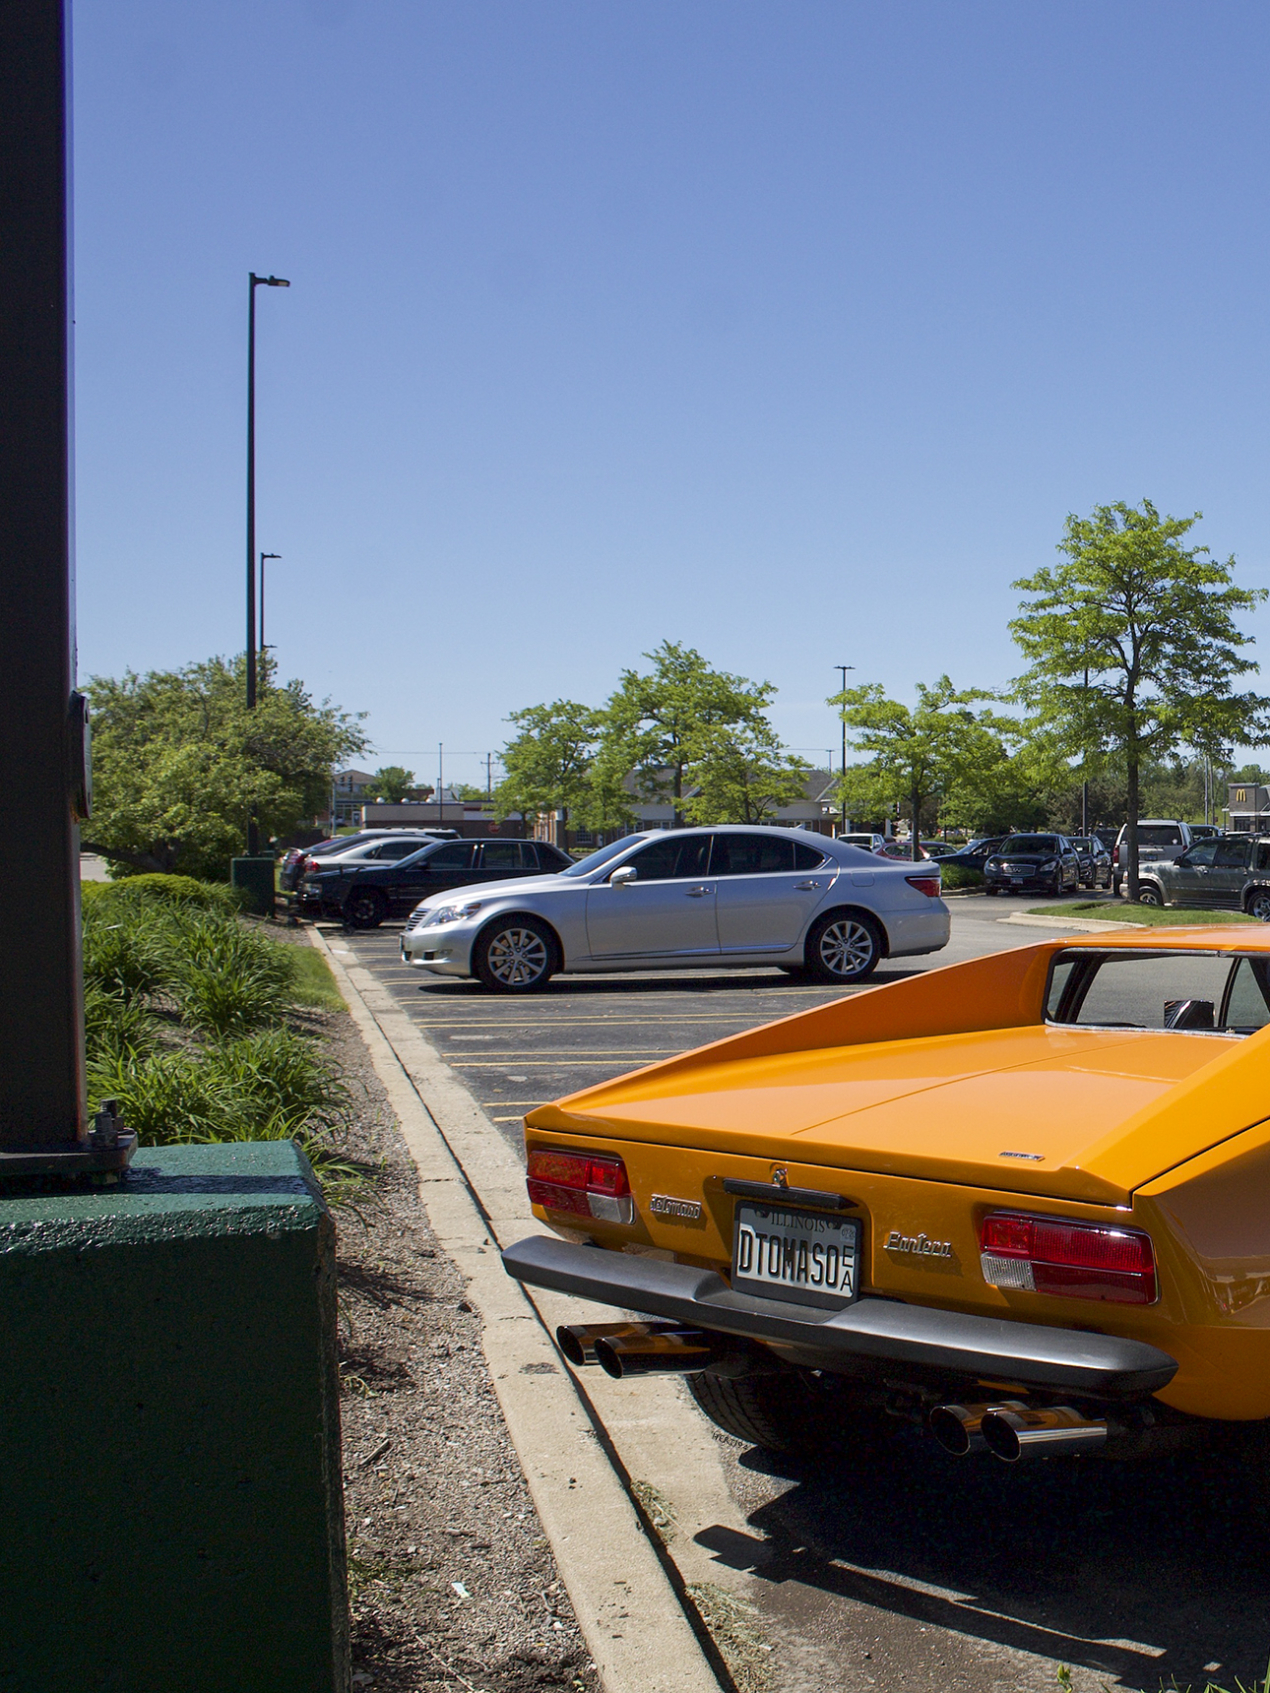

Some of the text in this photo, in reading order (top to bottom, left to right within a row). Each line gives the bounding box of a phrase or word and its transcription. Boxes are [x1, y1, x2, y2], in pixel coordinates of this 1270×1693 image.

[771, 1212, 825, 1233] ILLINOIS
[883, 1231, 952, 1257] Pantera
[739, 1229, 839, 1288] DTOMASO
